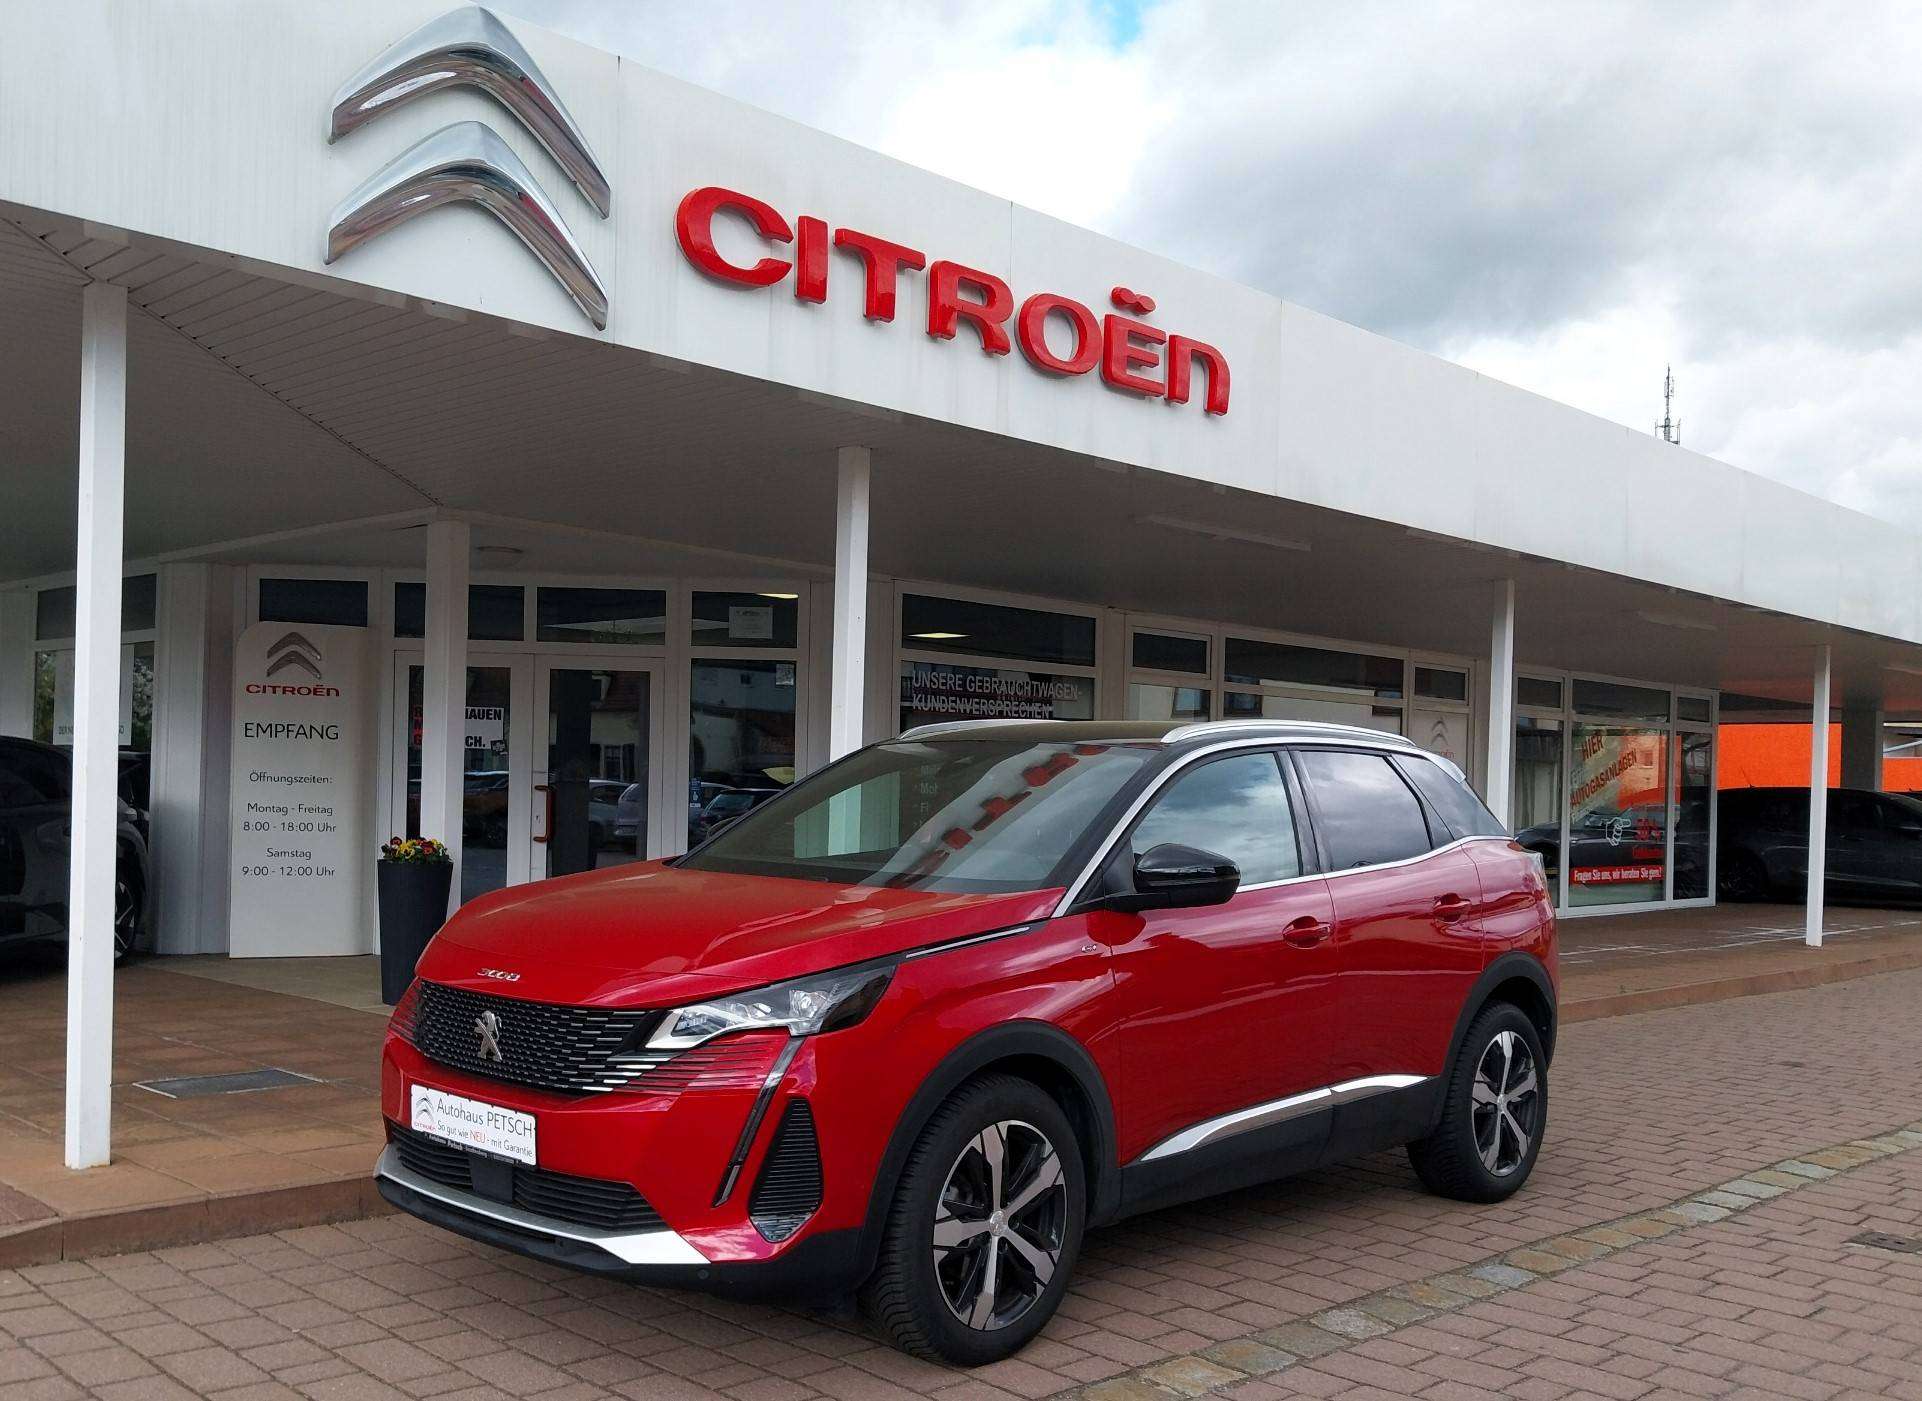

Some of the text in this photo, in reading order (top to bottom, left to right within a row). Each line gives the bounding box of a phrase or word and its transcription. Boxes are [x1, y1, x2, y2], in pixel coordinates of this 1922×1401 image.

[912, 669, 964, 691] UNSERE
[244, 722, 339, 740] EMPFANG
[1582, 731, 1604, 761] HIER
[249, 769, 333, 785] Öffnungszeiten:
[1570, 749, 1637, 808] AUTOGASANLAGEN
[247, 803, 289, 816] Montag
[298, 803, 333, 816] Freitag
[243, 821, 270, 831] 8:00
[281, 822, 314, 832] 18:00
[317, 822, 337, 832] Uhr
[266, 847, 312, 860] Samstag
[242, 866, 269, 876] 9:00
[280, 866, 313, 876] 12:00
[316, 866, 336, 876] Uhr
[437, 1098, 532, 1138] Autohaus PETSCH
[437, 1120, 446, 1131] So
[447, 1124, 457, 1136] gut
[458, 1128, 468, 1139] wie
[470, 1129, 486, 1143] NEU
[491, 1138, 502, 1149] mit
[503, 1139, 533, 1158] Garantie
